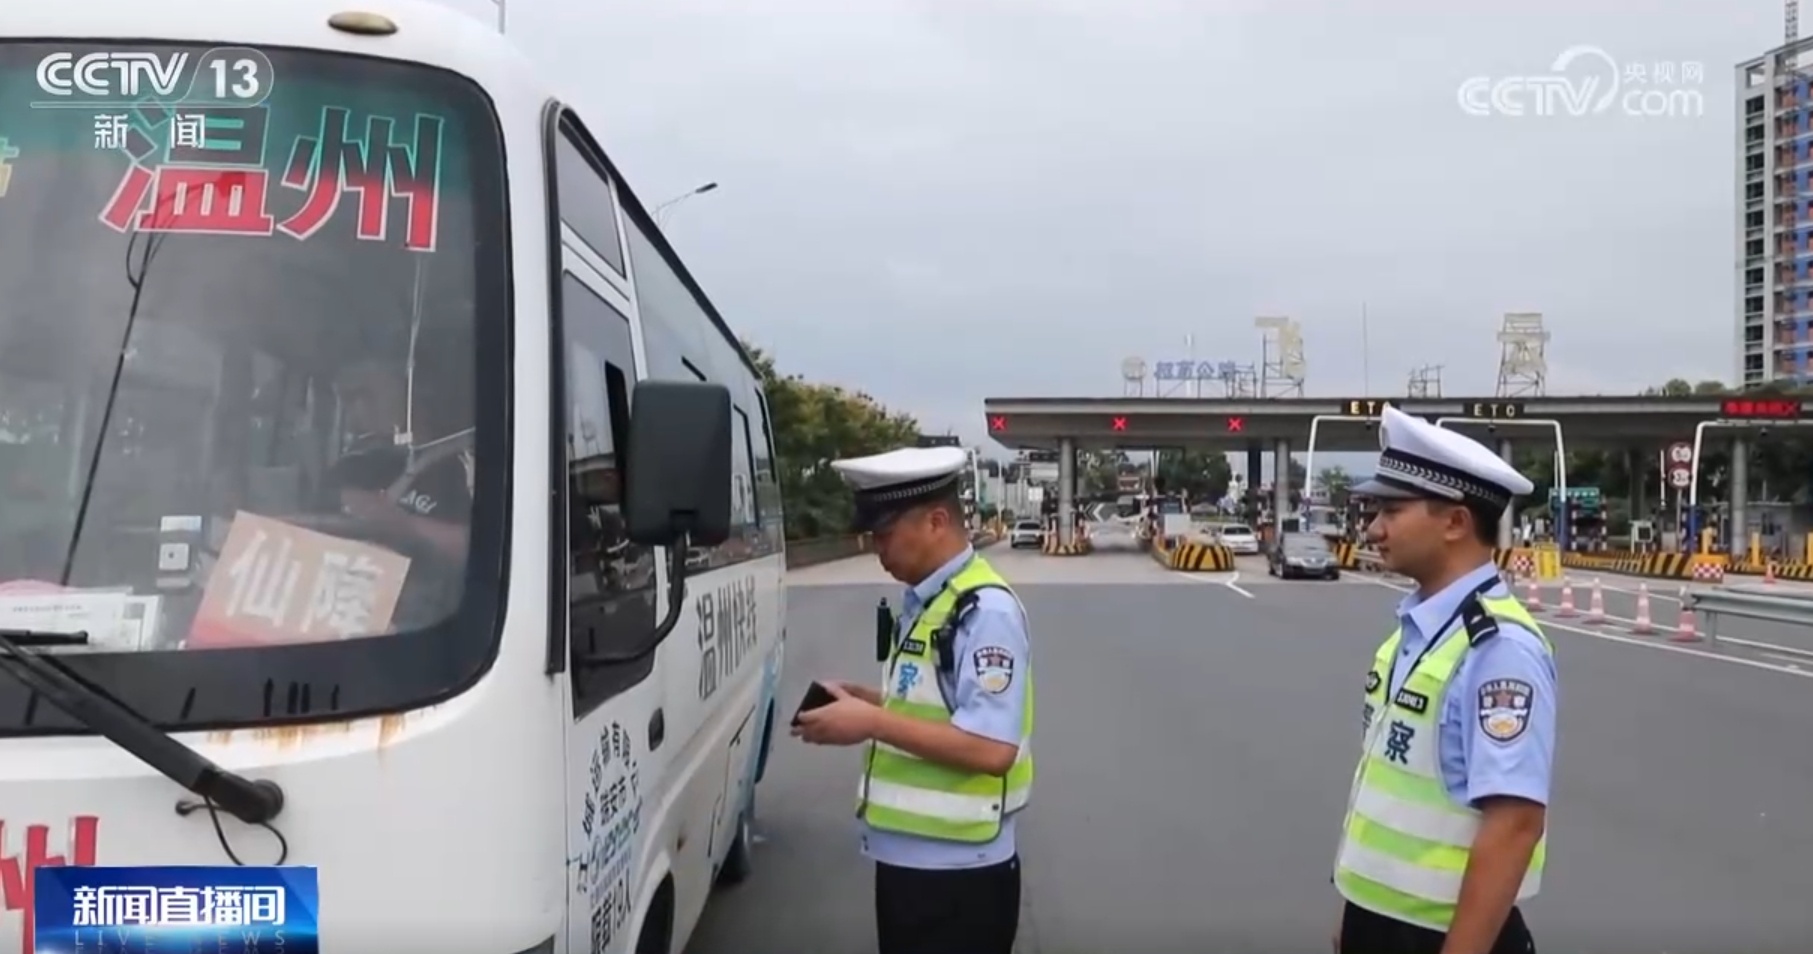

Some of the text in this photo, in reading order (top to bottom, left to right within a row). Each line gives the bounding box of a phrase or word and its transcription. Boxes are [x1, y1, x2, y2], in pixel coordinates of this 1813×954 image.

[100, 97, 444, 252] 温州
[1473, 404, 1516, 418] ETC
[696, 574, 757, 701] 温州快线
[1384, 720, 1415, 765] 察
